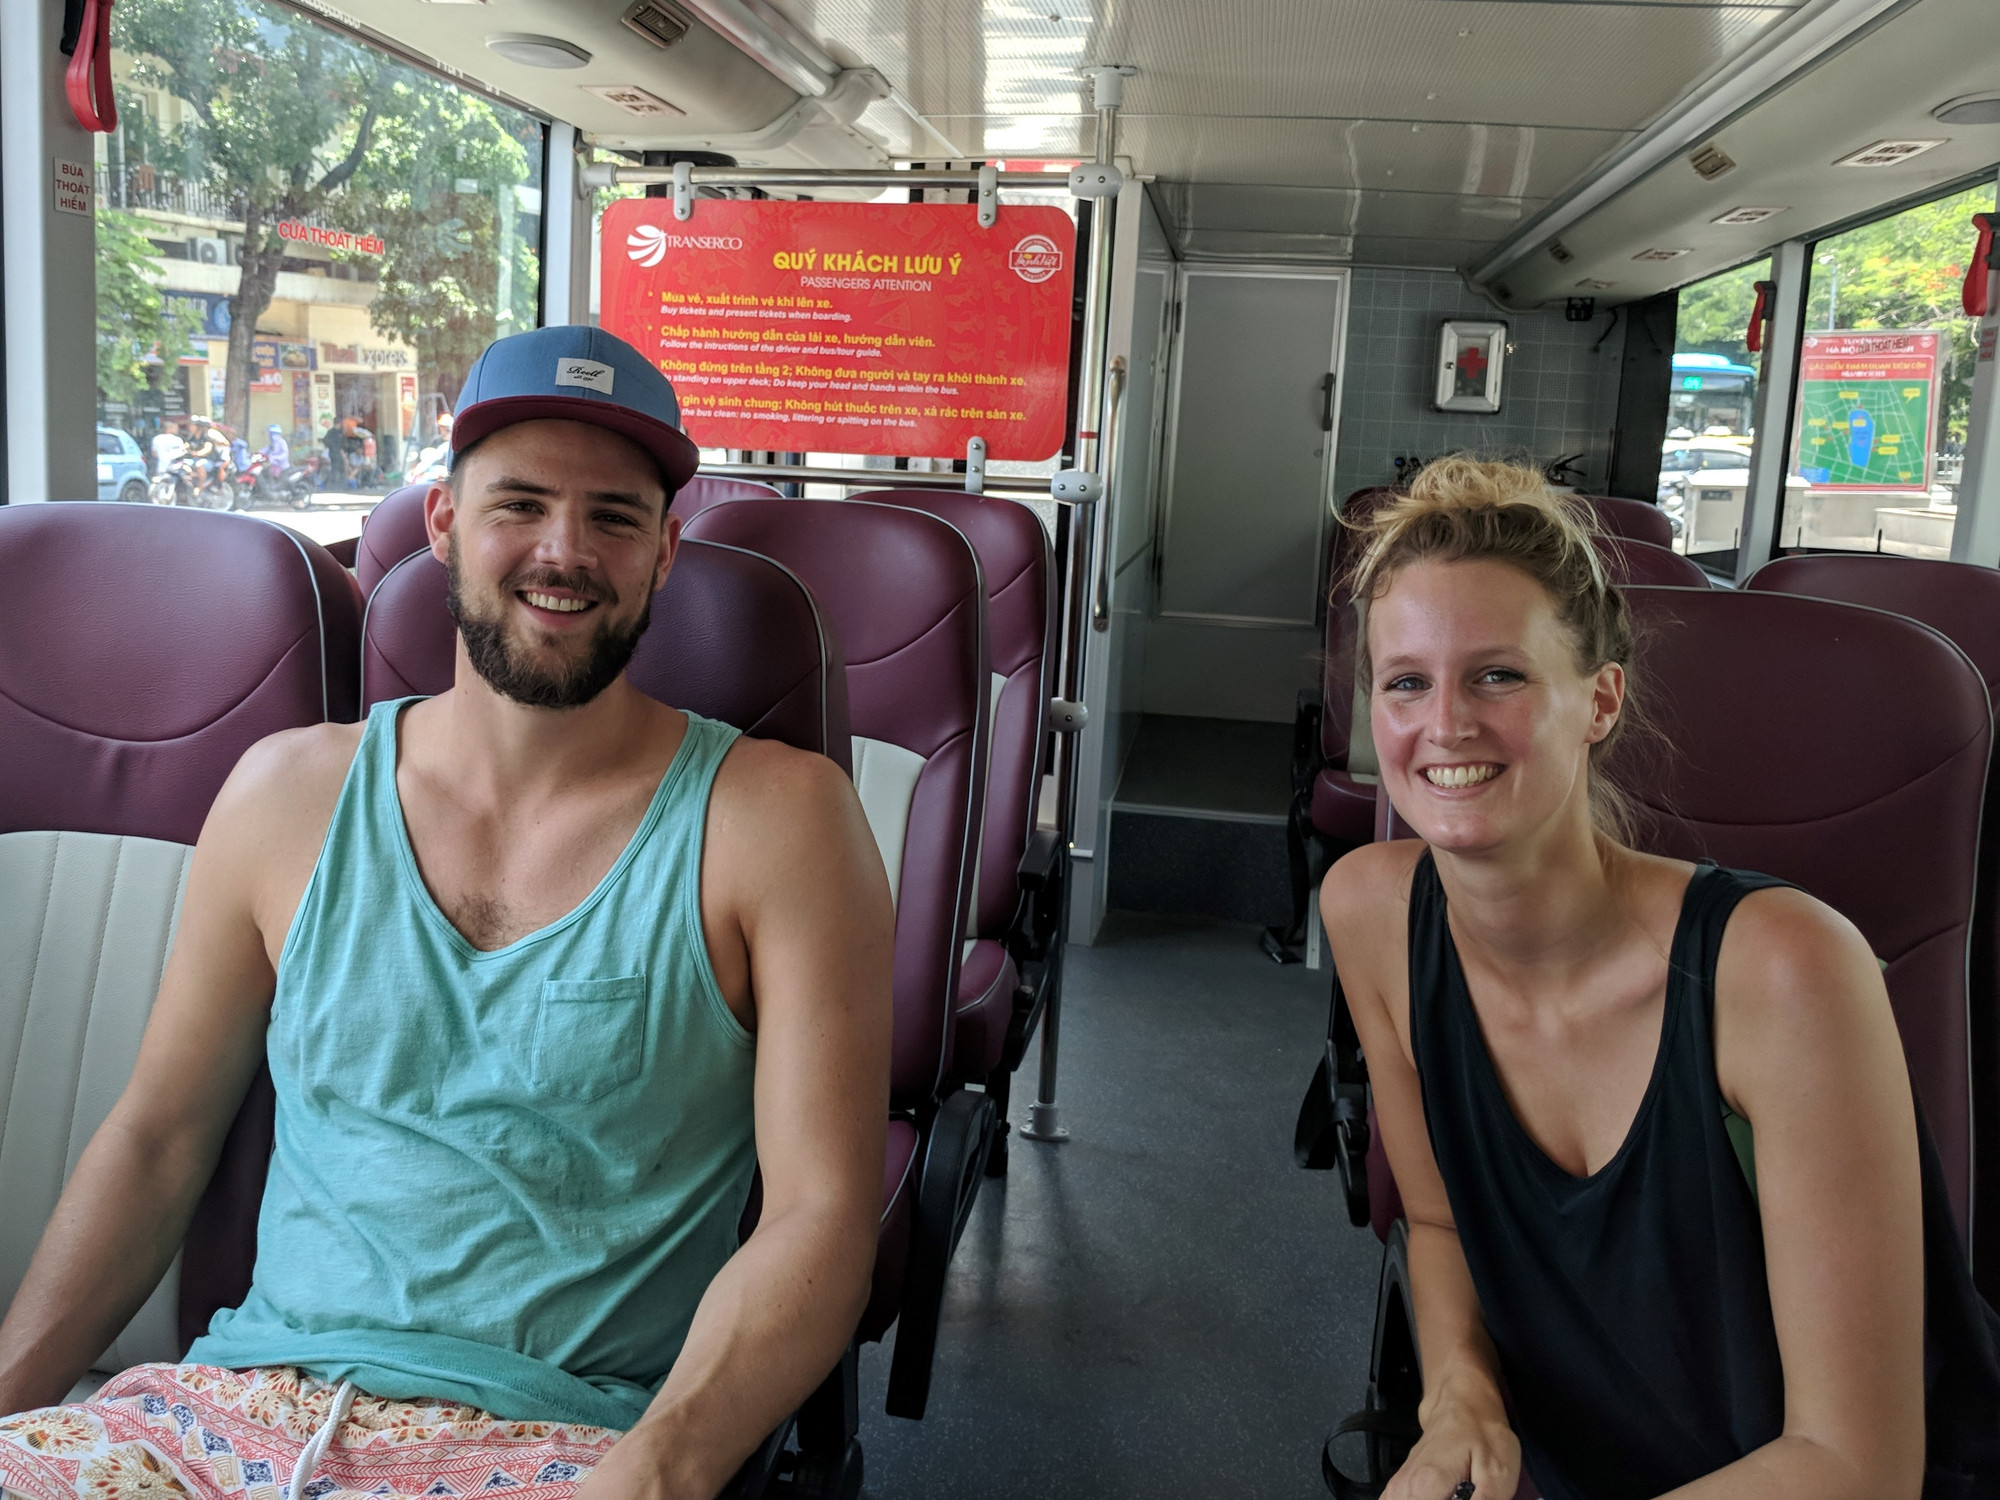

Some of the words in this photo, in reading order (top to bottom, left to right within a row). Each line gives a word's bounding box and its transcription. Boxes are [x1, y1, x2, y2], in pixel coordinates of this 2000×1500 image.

[56, 179, 90, 195] THOÁT
[279, 217, 308, 241] CỬA
[310, 226, 352, 249] THOÁT
[667, 235, 743, 250] TRANSERCO
[773, 248, 817, 270] QUÝ
[823, 249, 898, 273] KHÁCH
[904, 254, 942, 275] LƯU
[948, 252, 962, 275] Ý
[800, 276, 871, 290] PASSENGERS
[872, 279, 932, 291] ATTENTION
[662, 292, 685, 303] Mua
[706, 293, 730, 305] xuất
[733, 295, 758, 306] trình
[761, 295, 774, 306] vé
[777, 297, 794, 307] khi
[797, 298, 814, 308] lên
[817, 300, 833, 308] xe.
[660, 305, 678, 315] Buy
[679, 307, 706, 316] tickets
[708, 308, 724, 317] and
[725, 309, 757, 318] present
[759, 309, 786, 319] tickets
[788, 311, 811, 319] when
[812, 312, 852, 322] boarding.
[661, 325, 690, 339] Chấp
[692, 327, 720, 339] hành
[722, 328, 760, 342] hướng
[762, 328, 783, 340] dẫn
[785, 330, 806, 342] của
[808, 332, 822, 342] lái
[825, 333, 841, 344] xe,
[844, 333, 882, 347] hướng
[884, 333, 906, 346] dẫn
[908, 336, 935, 347] viên.
[660, 339, 688, 348] Follow
[689, 341, 702, 349] the
[704, 341, 748, 351] intructions
[750, 343, 759, 351] of
[761, 344, 774, 352] the
[776, 345, 800, 353] driver
[801, 346, 818, 354] and
[819, 346, 855, 356] bus/tour
[856, 348, 882, 358] guide.
[660, 359, 696, 373] Không
[699, 361, 728, 375] đứng
[730, 363, 752, 374] trên
[755, 361, 779, 377] tầng
[782, 365, 792, 376] 2;
[795, 365, 833, 380] Không
[835, 367, 857, 378] đưa
[859, 370, 895, 382] người
[896, 371, 910, 381] và
[912, 372, 931, 384] tay
[933, 374, 945, 382] ra
[947, 372, 972, 384] khỏi
[974, 373, 1007, 385] thành
[1010, 377, 1027, 386] xe.
[673, 374, 708, 385] standing
[723, 377, 747, 387] upper
[749, 378, 772, 387] deck;
[773, 379, 785, 387] Do
[787, 380, 807, 389] keep
[808, 381, 827, 390] your
[829, 381, 850, 390] head
[852, 382, 868, 391] and
[869, 384, 896, 392] hands
[898, 385, 923, 393] within
[925, 386, 938, 394] the
[940, 387, 959, 395] bus.
[681, 408, 697, 416] the
[697, 409, 712, 417] bus
[714, 410, 738, 418] clean:
[753, 412, 790, 423] smoking,
[792, 412, 824, 424] littering
[826, 415, 835, 423] or
[837, 415, 868, 427] spitting
[871, 418, 881, 426] on
[883, 418, 897, 426] the
[899, 418, 917, 427] bus.
[682, 395, 699, 407] gìn
[702, 396, 715, 408] vệ
[718, 397, 742, 407] sinh
[785, 398, 821, 413] Không
[824, 400, 843, 412] hút
[845, 401, 877, 413] thuốc
[880, 403, 901, 415] trên
[904, 407, 921, 417] xe,
[924, 404, 937, 417] xả
[940, 405, 958, 418] rác
[961, 407, 983, 419] trên
[986, 409, 1007, 420] sàn
[1009, 412, 1026, 421] xe.
